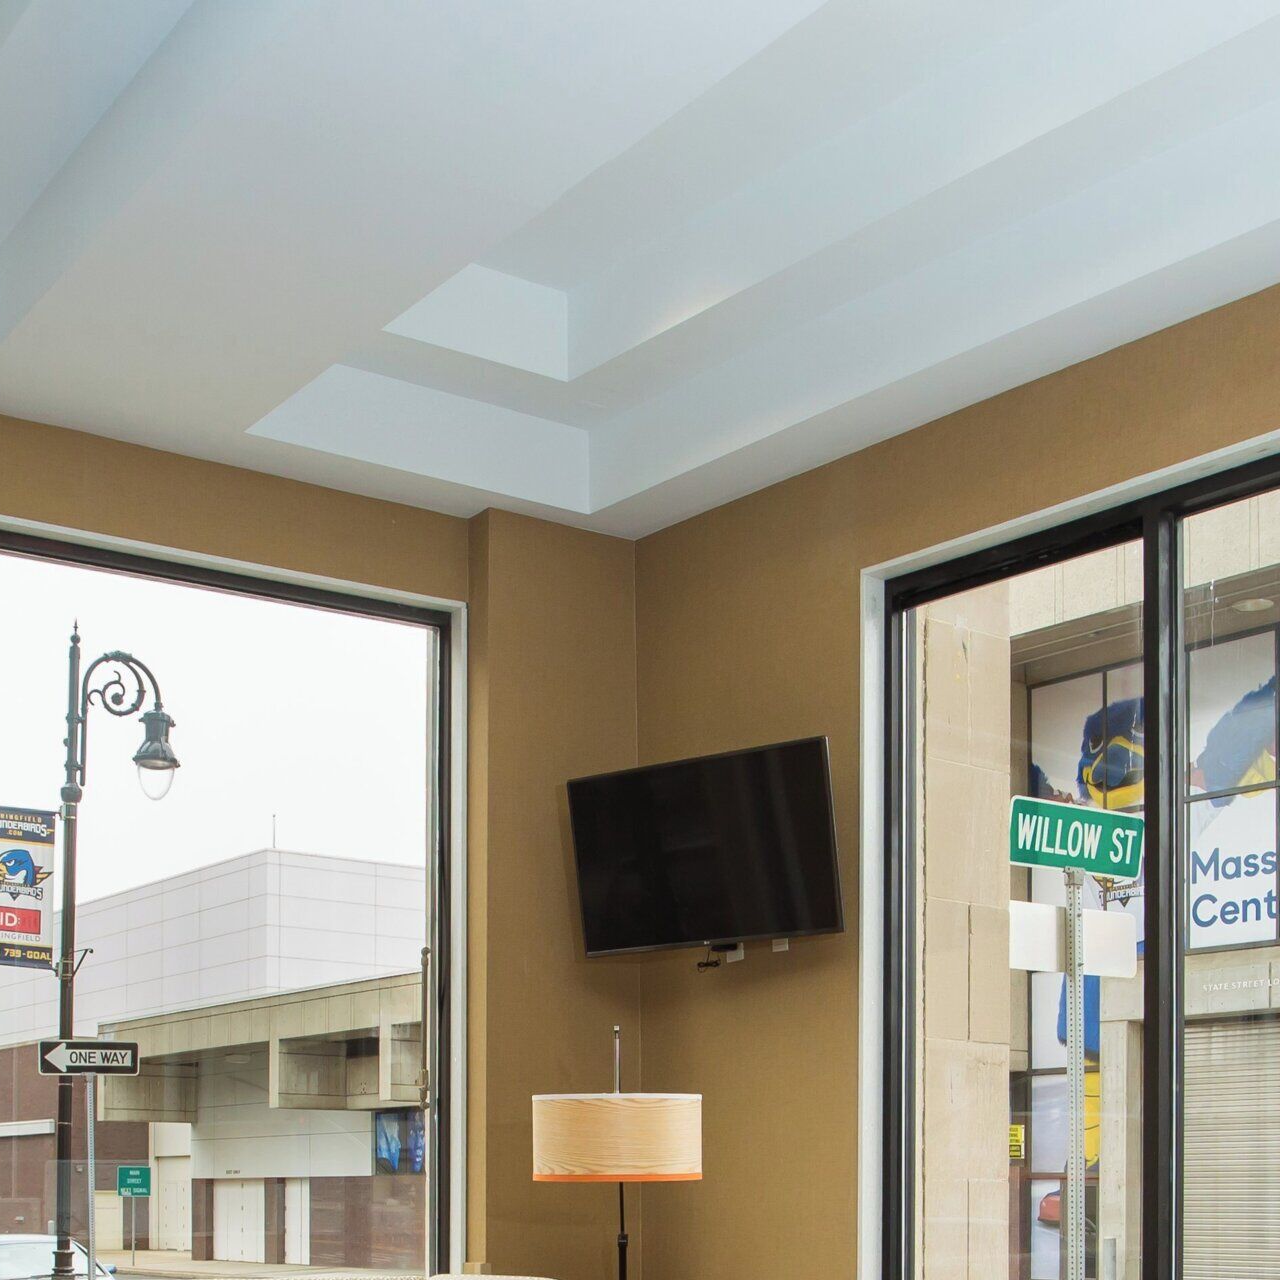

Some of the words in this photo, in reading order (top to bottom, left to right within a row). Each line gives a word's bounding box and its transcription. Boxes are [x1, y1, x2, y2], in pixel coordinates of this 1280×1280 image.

[1018, 812, 1103, 860] WILLOW
[1109, 827, 1138, 865] ST
[3, 947, 52, 960] 739-GOAL
[1203, 983, 1229, 992] STATE
[1231, 979, 1265, 990] STREET
[69, 1051, 97, 1064] ONE
[100, 1051, 128, 1065] WAY
